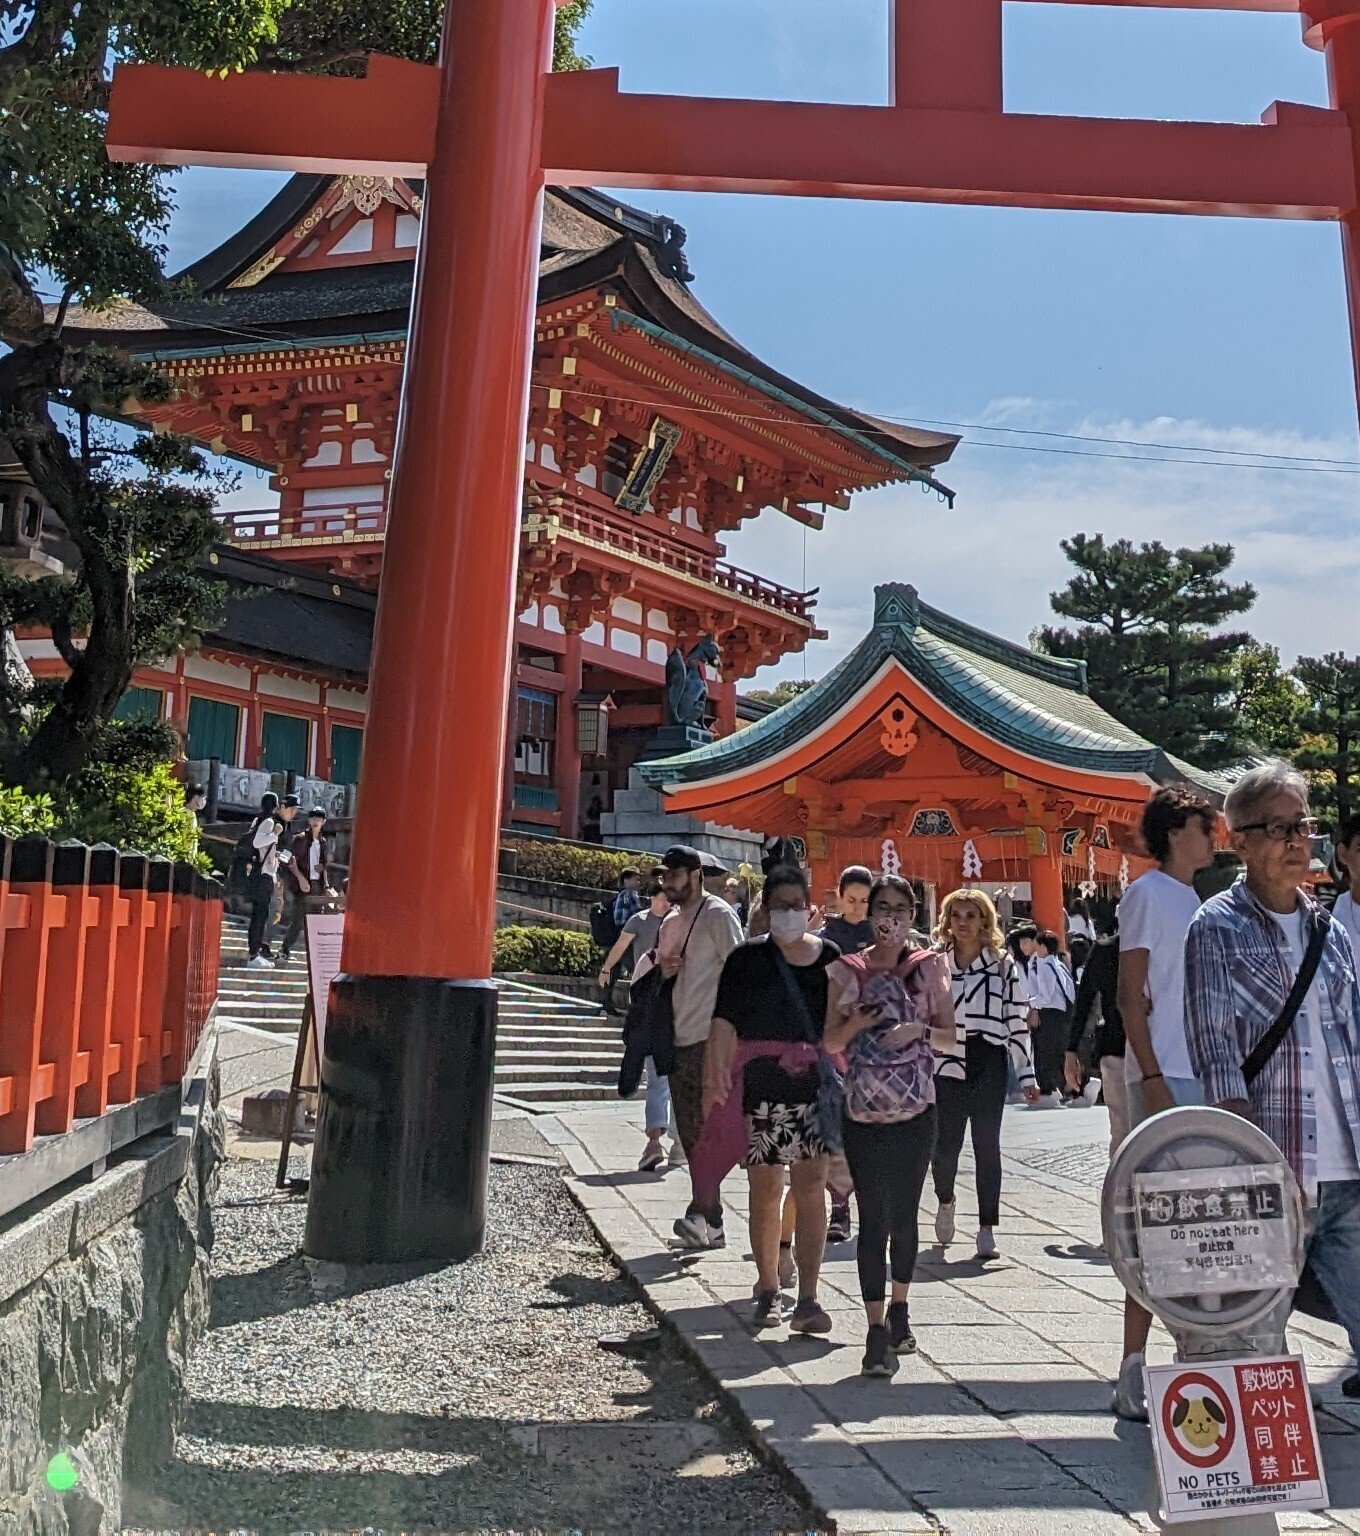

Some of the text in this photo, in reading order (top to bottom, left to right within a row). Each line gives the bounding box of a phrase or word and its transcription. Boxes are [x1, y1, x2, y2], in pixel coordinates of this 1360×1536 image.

[1177, 1191, 1274, 1219] 飲食禁止
[1170, 1225, 1259, 1240] Do not eat here
[1241, 1365, 1295, 1392] 敷地内
[1251, 1395, 1296, 1419] ペット
[1254, 1423, 1302, 1450] 同伴
[1260, 1452, 1309, 1480] 禁止
[1178, 1471, 1240, 1490] NO PETS
